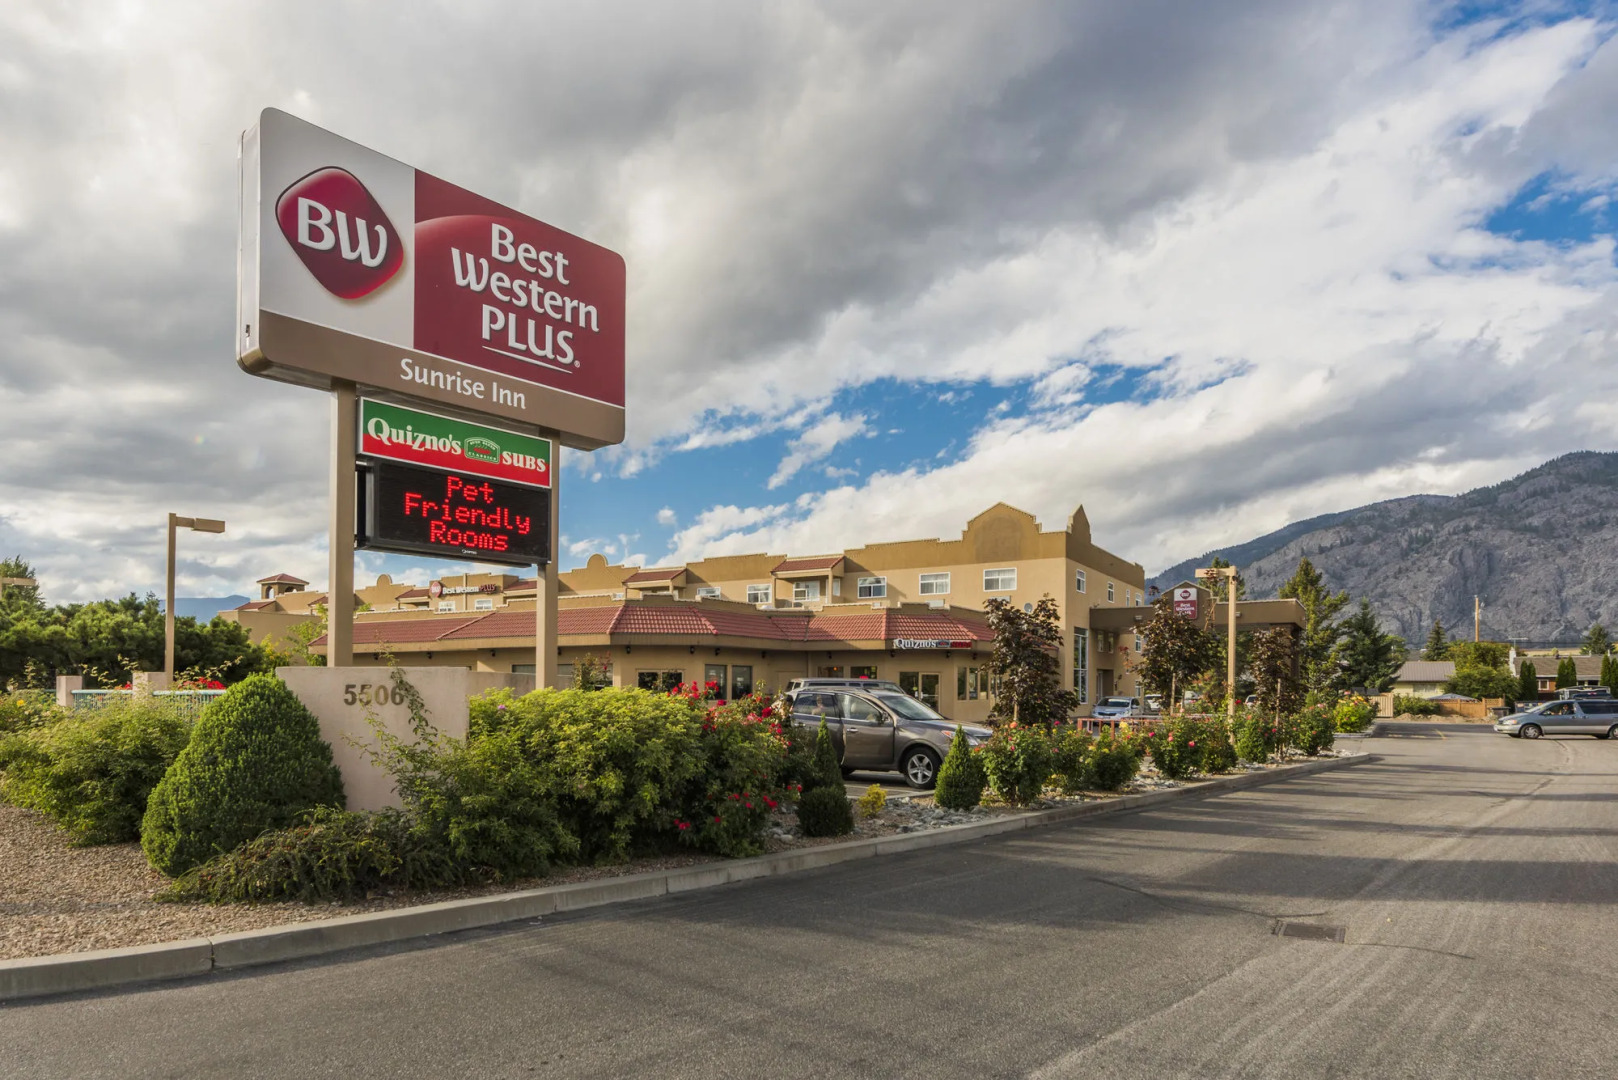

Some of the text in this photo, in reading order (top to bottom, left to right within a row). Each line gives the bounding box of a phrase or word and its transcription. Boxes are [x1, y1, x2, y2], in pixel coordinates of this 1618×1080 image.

[297, 196, 388, 268] BW
[490, 222, 570, 285] Best
[450, 246, 600, 333] Western
[481, 303, 576, 366] PLUS
[400, 358, 527, 409] Sunrise Inn
[367, 417, 546, 473] Quizno's SUBS
[404, 491, 531, 535] Friendly
[447, 476, 494, 504] Pet
[430, 520, 509, 551] Rooms
[343, 684, 405, 706] 5506
